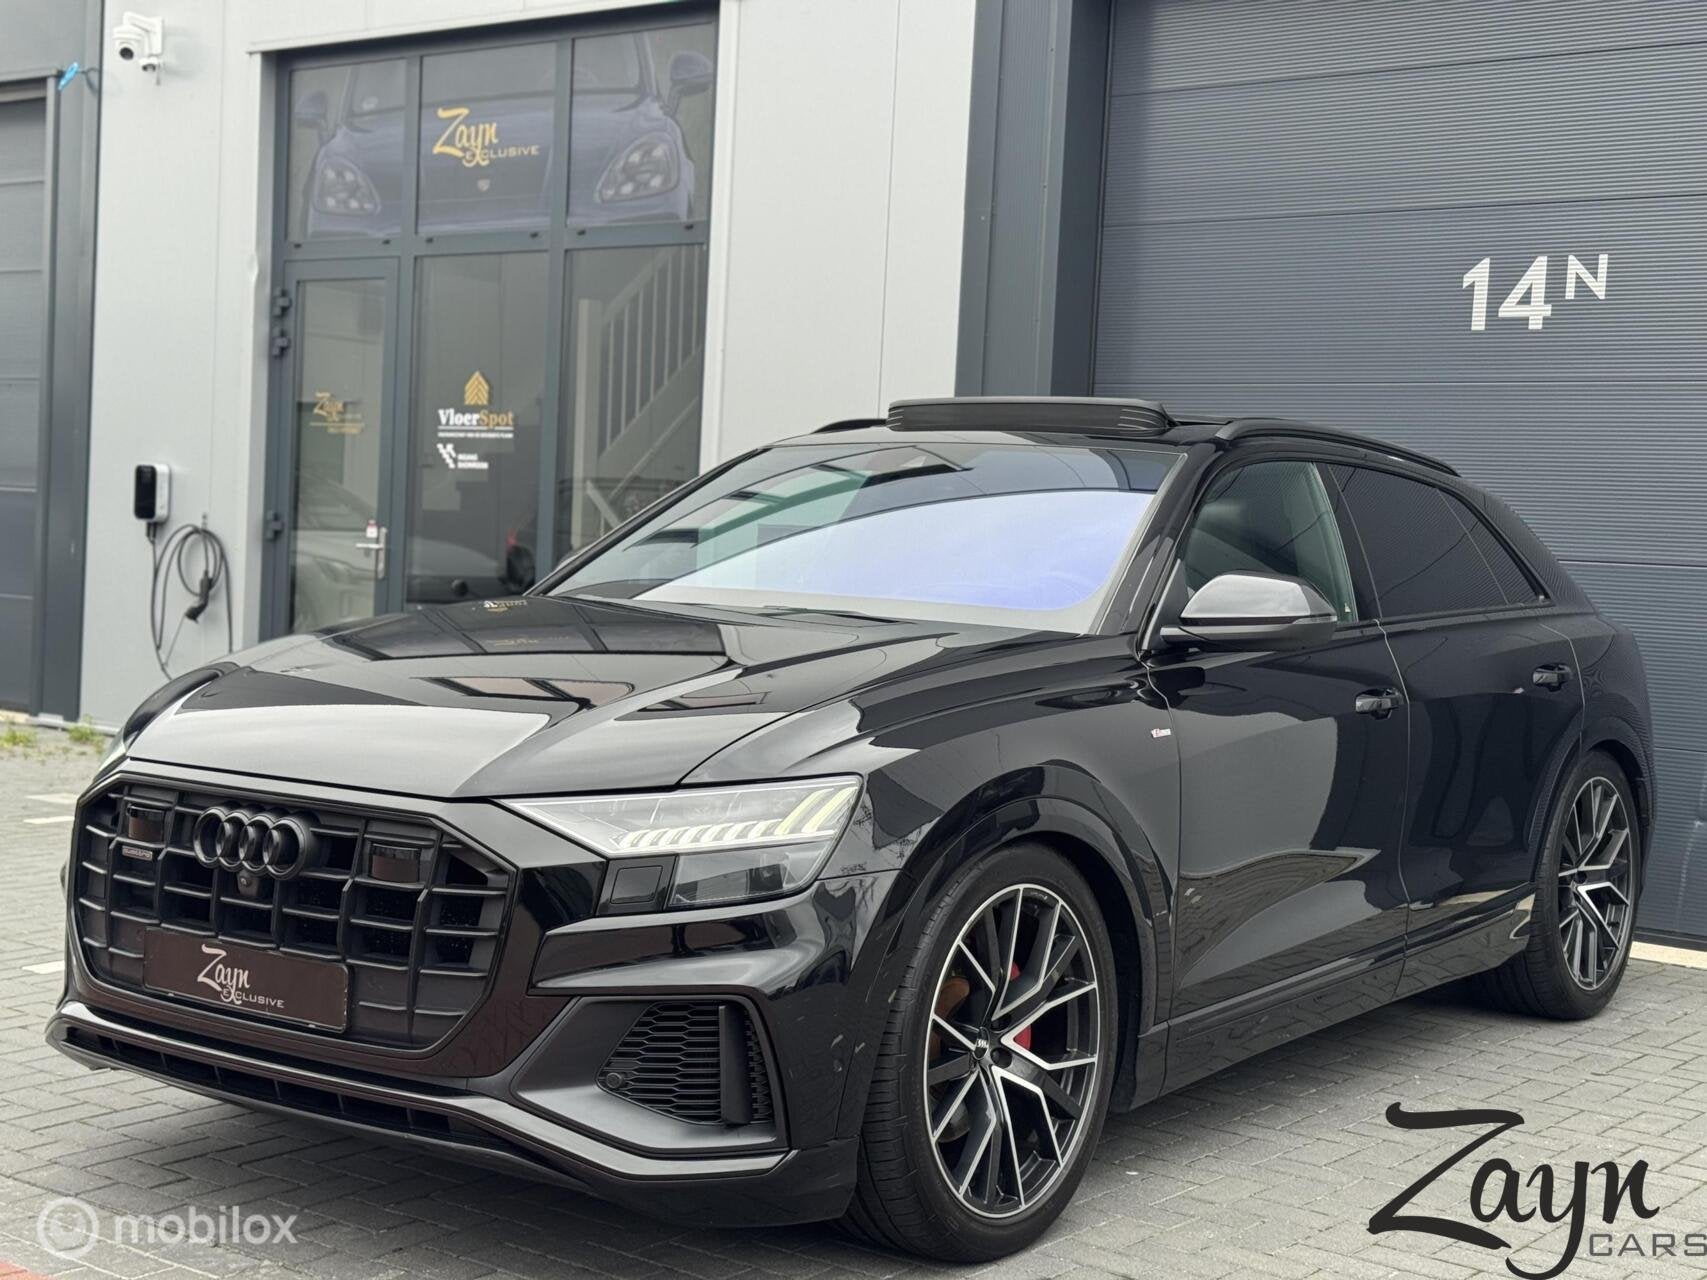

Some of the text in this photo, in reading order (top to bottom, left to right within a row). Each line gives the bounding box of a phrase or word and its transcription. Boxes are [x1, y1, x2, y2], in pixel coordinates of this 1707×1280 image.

[432, 107, 499, 167] Zayn
[437, 407, 514, 430] VloerSpot
[197, 943, 251, 1005] Zayn
